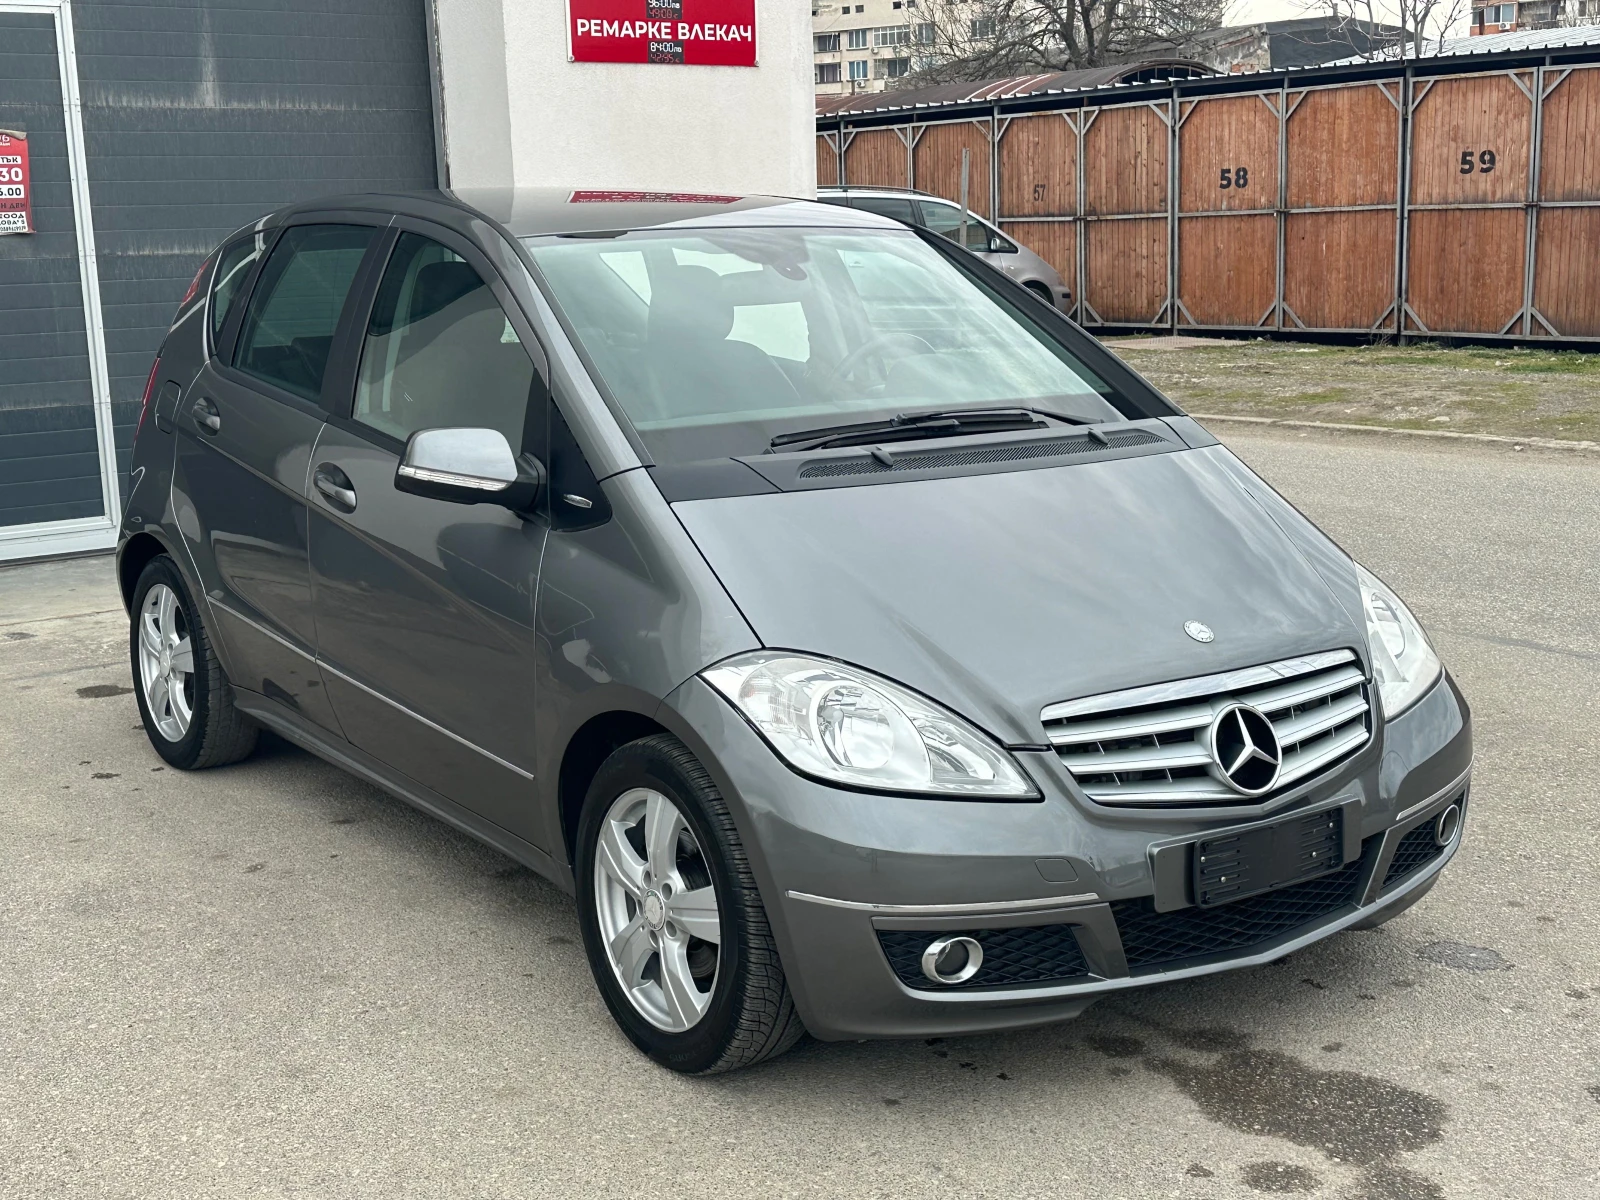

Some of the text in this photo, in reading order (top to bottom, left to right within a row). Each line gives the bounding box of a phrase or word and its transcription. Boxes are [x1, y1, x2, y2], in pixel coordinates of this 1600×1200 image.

[576, 19, 752, 41] РЕМАРКЕ ВЛЕКАЧ
[1460, 150, 1496, 174] 59
[1219, 167, 1249, 189] 58
[1033, 184, 1046, 202] 57
